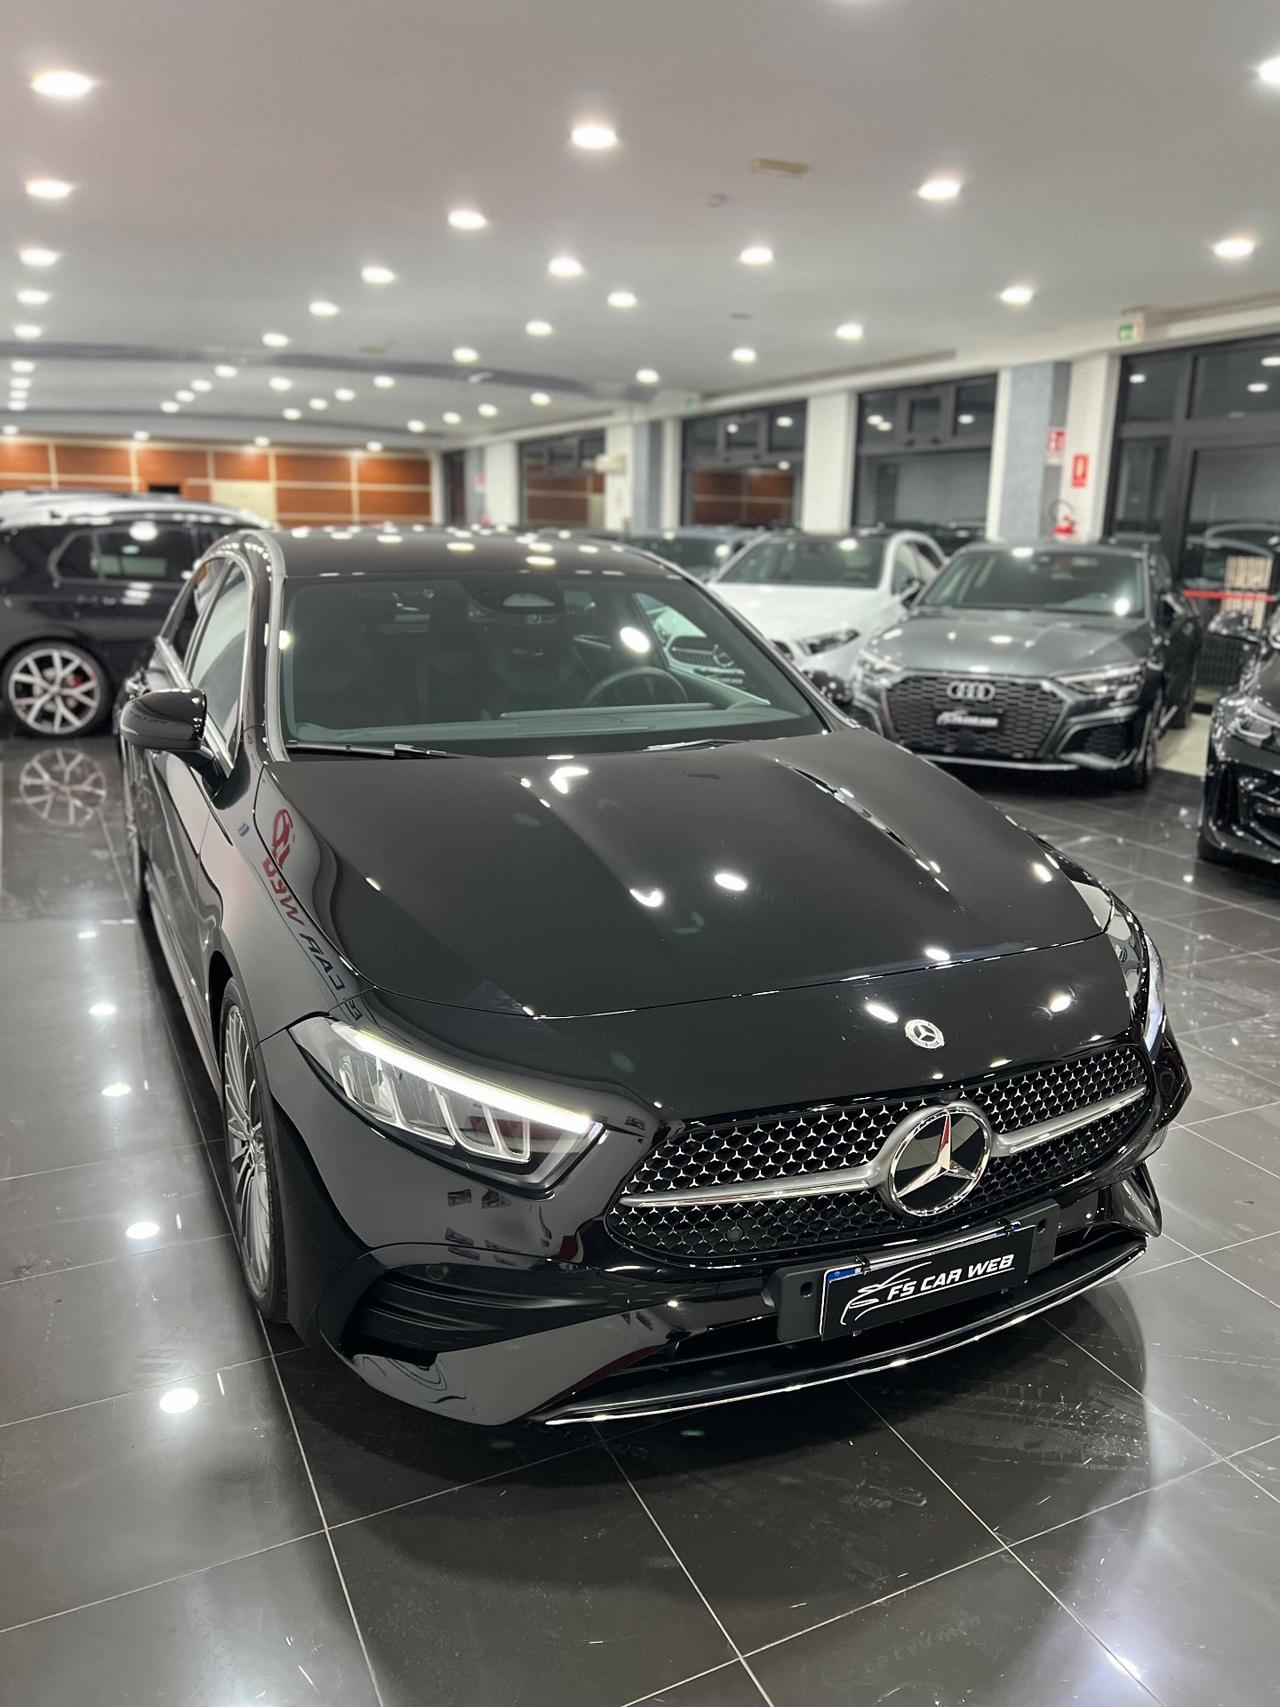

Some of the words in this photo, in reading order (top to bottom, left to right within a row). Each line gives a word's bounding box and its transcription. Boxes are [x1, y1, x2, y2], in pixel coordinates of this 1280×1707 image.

[886, 1280, 918, 1301] FS
[920, 1268, 963, 1292] CAR
[967, 1253, 1015, 1279] WEB
